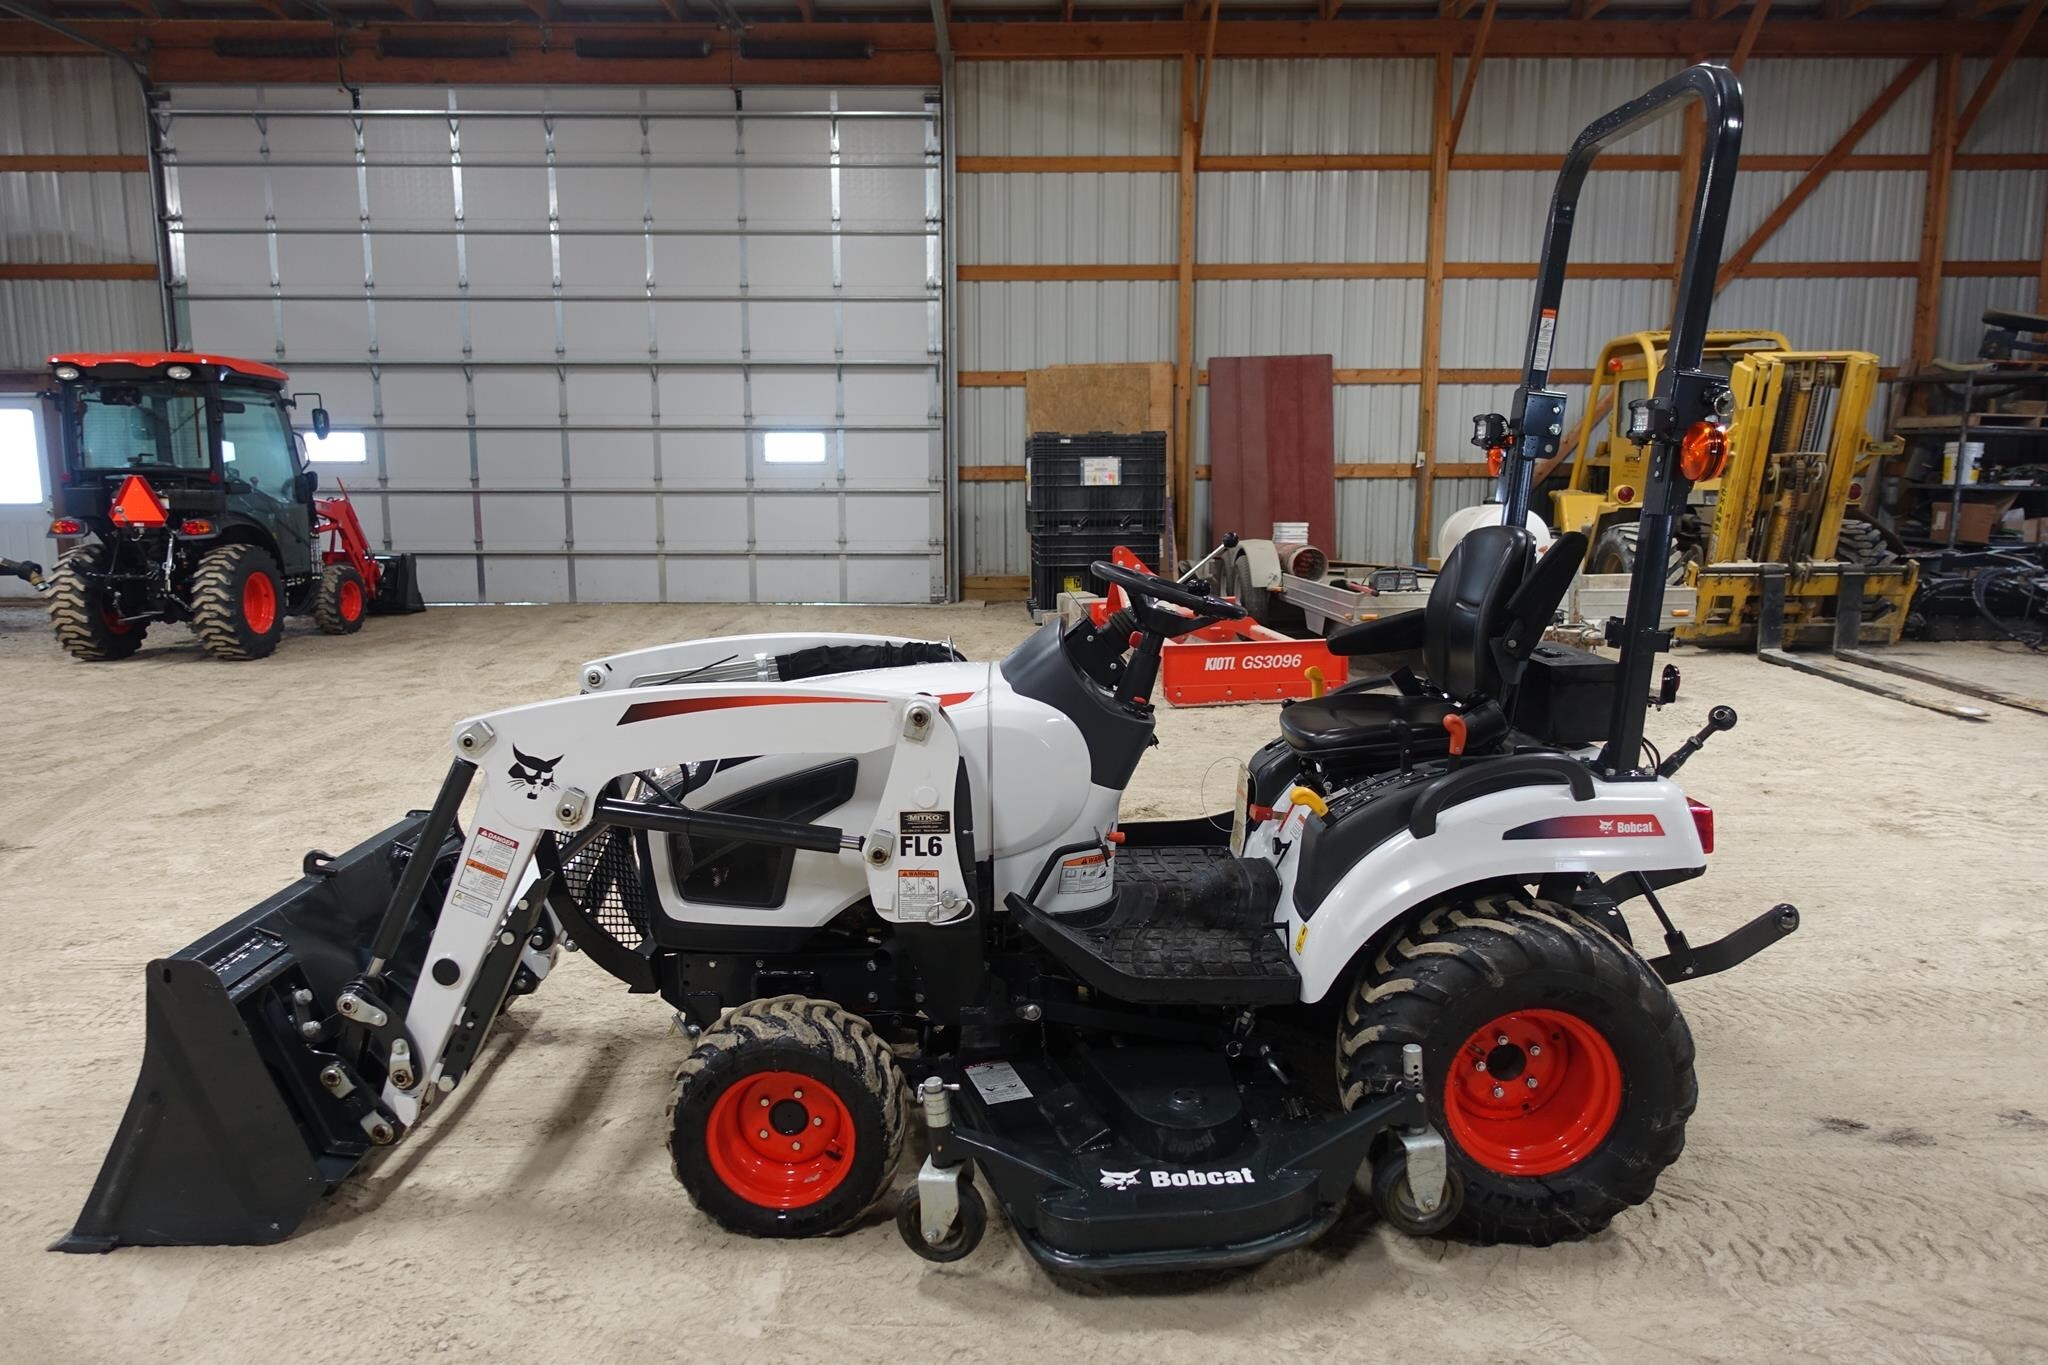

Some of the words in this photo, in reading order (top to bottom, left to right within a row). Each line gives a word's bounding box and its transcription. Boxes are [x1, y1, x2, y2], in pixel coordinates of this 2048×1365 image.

[1205, 656, 1235, 671] KIOTI
[1242, 654, 1302, 669] GS3096
[1617, 821, 1653, 833] Bobcat
[487, 831, 515, 847] DANGER
[900, 835, 943, 857] FL6
[1150, 1167, 1256, 1187] Bobcat
